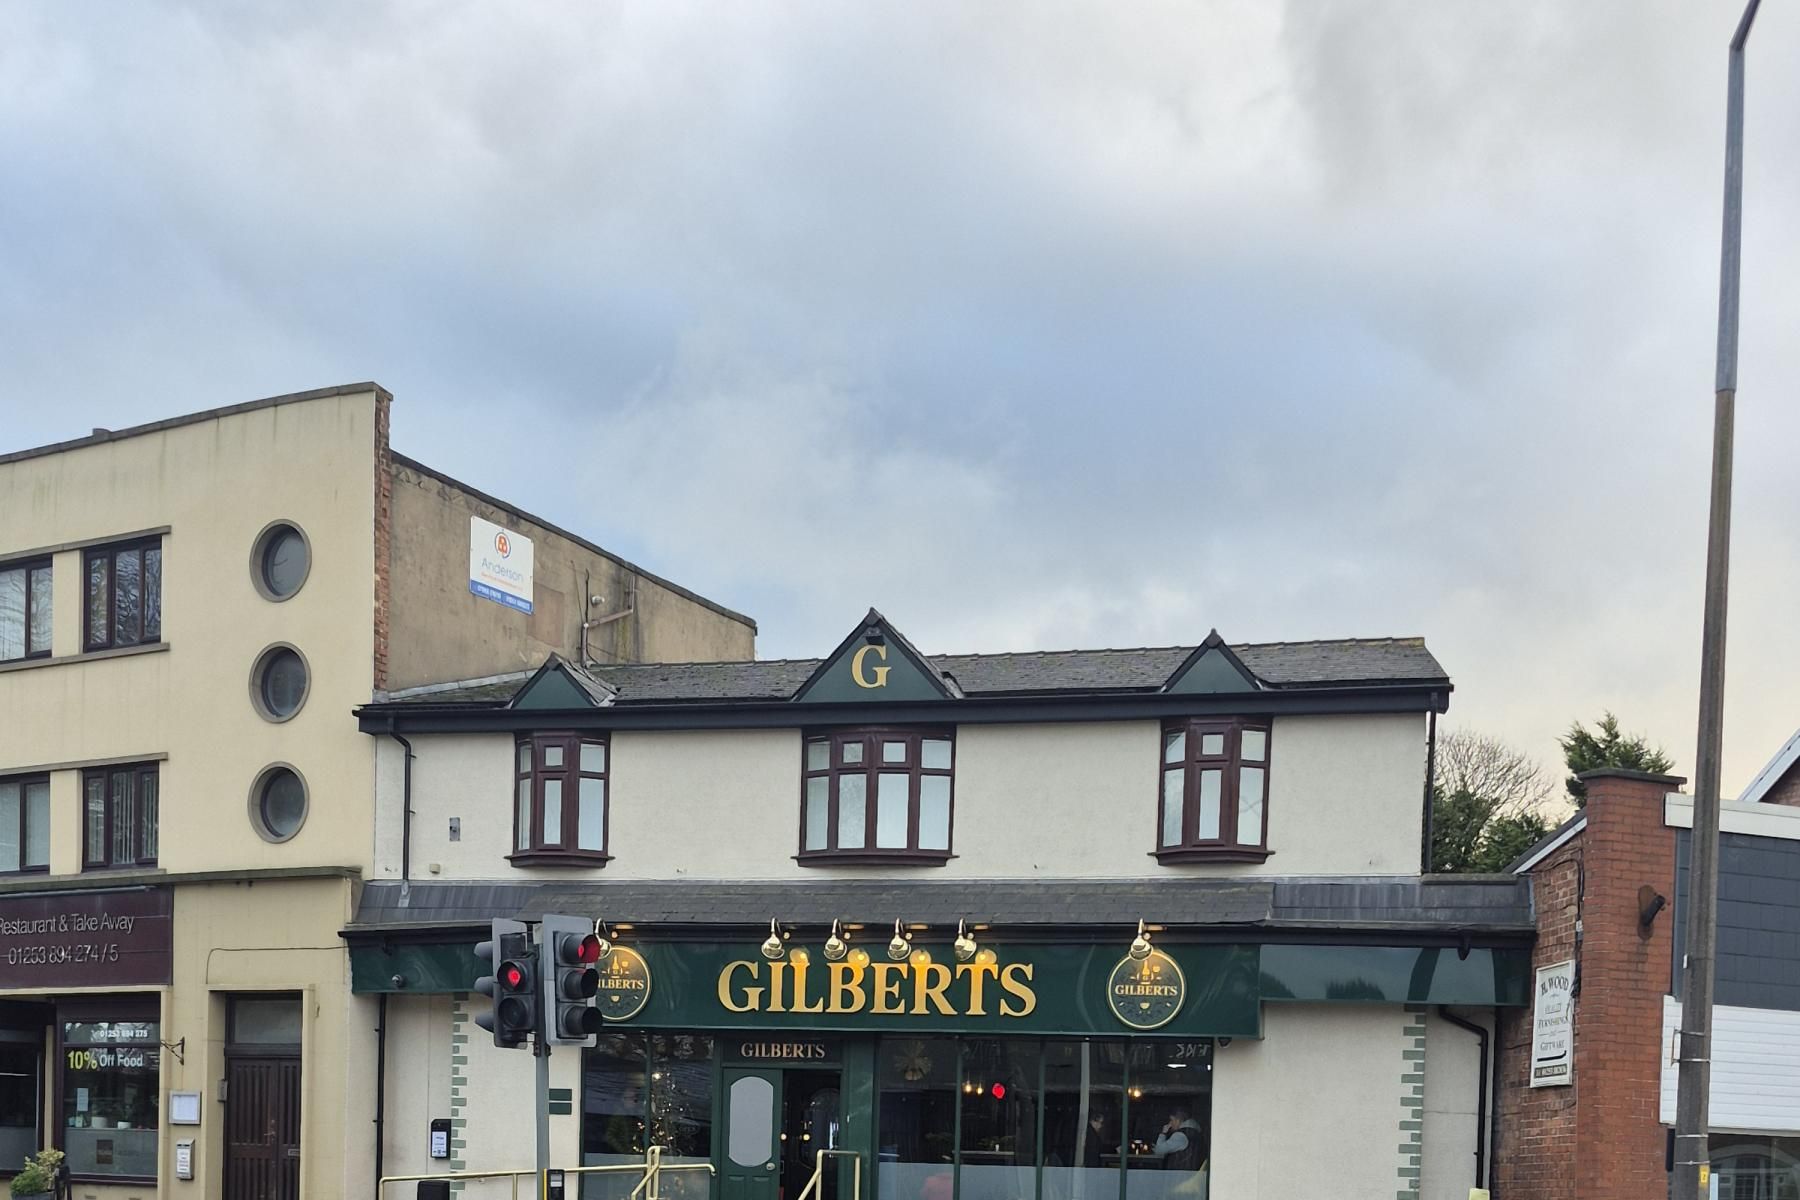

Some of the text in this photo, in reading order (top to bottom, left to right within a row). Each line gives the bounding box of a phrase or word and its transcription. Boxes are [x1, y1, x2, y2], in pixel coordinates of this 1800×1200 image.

[481, 558, 524, 582] Anderson
[851, 644, 892, 689] G
[58, 914, 69, 933] &
[71, 912, 98, 933] Take
[100, 911, 135, 935] Away
[8, 943, 119, 965] 01253 894 274 / 5
[597, 979, 645, 990] ILBERTS
[717, 959, 1037, 1017] GILBERTS
[1114, 984, 1178, 996] GILBERTS
[1548, 975, 1569, 991] WOOD
[67, 1050, 143, 1070] 10% Off Food
[741, 1042, 826, 1059] GILBERTS
